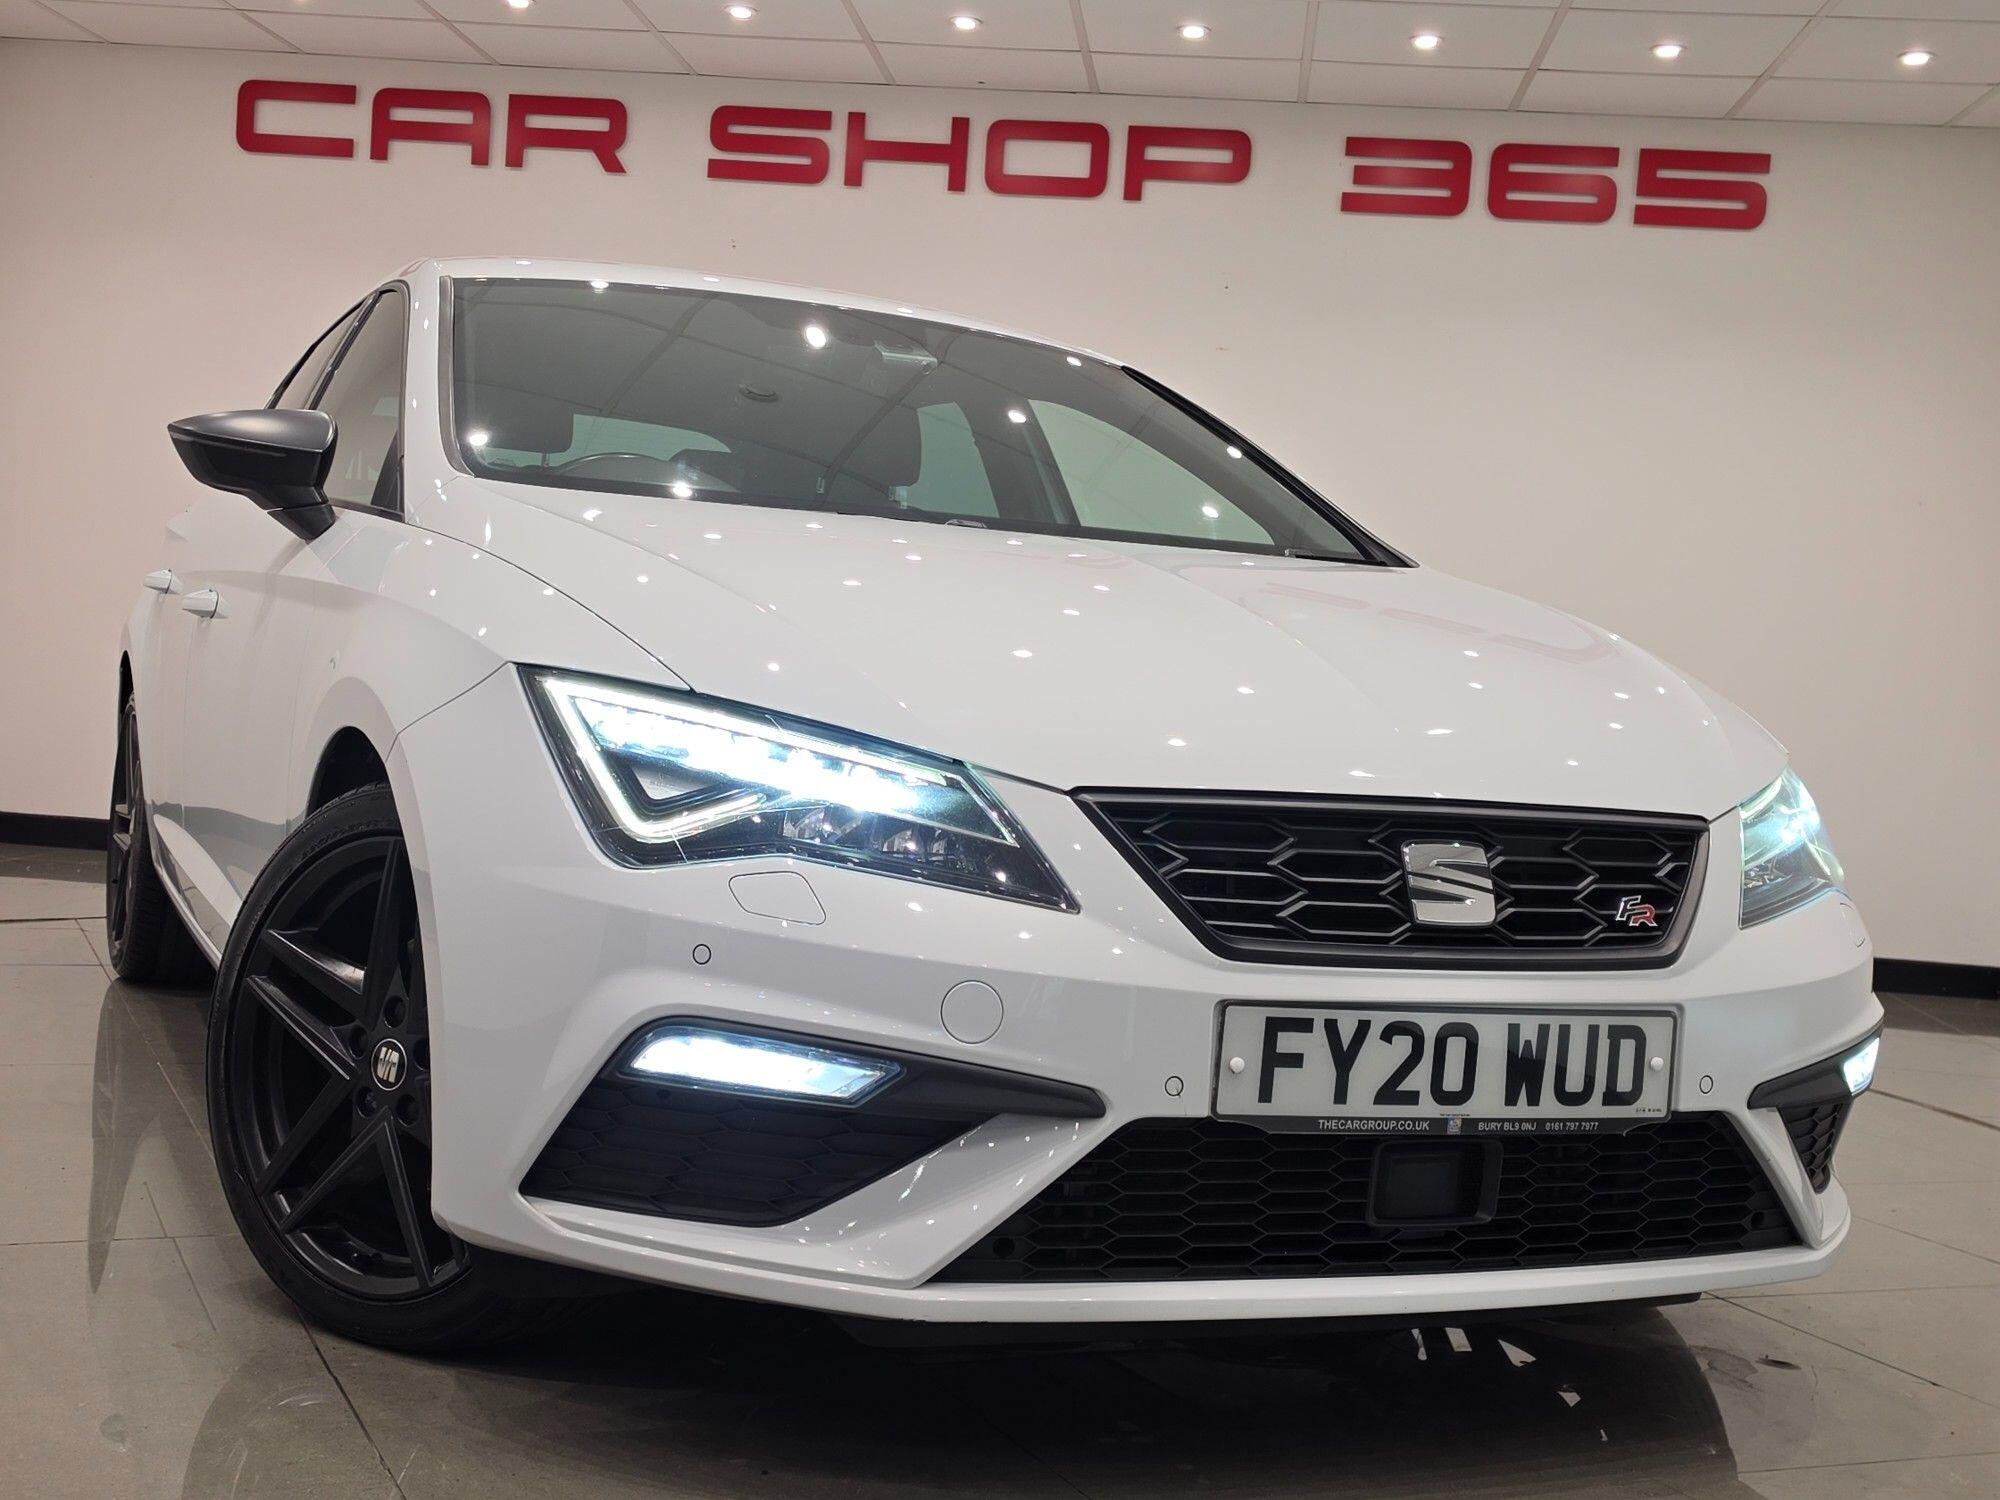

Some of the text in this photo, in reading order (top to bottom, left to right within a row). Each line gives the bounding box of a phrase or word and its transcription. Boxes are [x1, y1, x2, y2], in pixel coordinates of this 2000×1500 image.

[236, 79, 1771, 230] CAR SHOP 365
[1615, 895, 1658, 926] FR
[1257, 1015, 1648, 1107] FY20 WUD
[1318, 1119, 1430, 1131] THECARGROUP.CO.UK
[1478, 1121, 1502, 1131] BURY
[1503, 1121, 1520, 1131] BL9
[1545, 1121, 1563, 1131] 0161
[1565, 1121, 1580, 1131] 797
[1581, 1121, 1599, 1131] 7977
